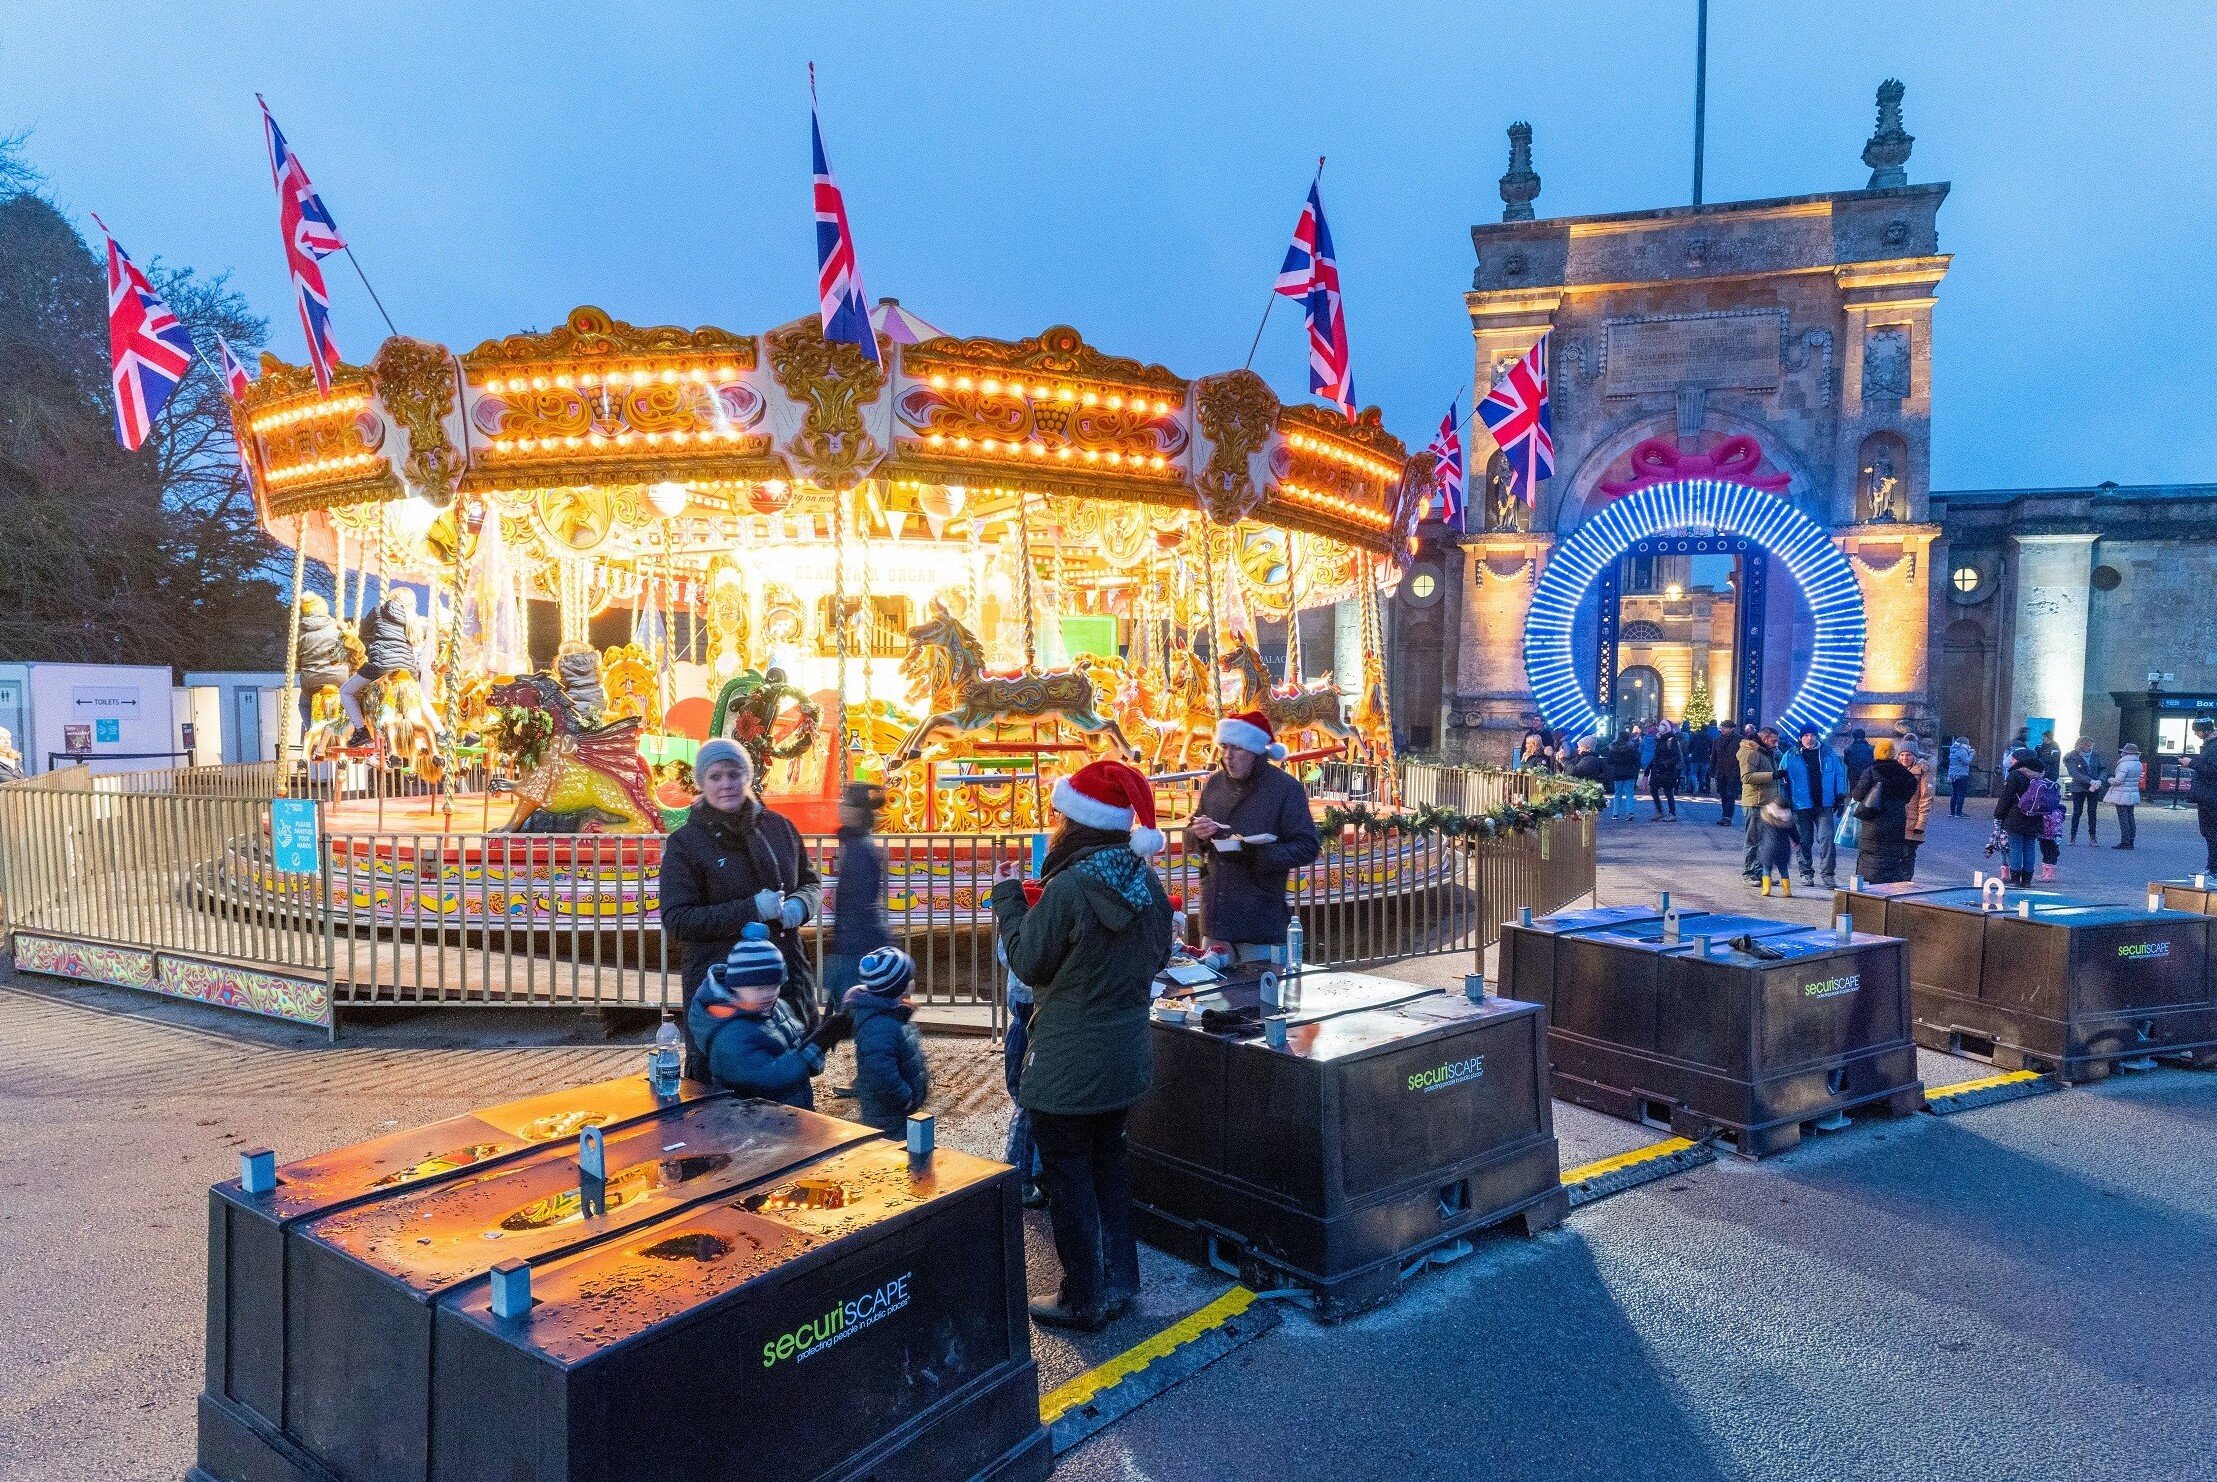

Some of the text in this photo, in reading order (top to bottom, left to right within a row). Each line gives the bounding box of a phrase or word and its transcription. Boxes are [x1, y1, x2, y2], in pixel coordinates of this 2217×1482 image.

[844, 567, 880, 582] FAR
[888, 568, 936, 583] ORGAN
[1259, 655, 1287, 664] PALAC
[797, 1339, 833, 1364] protecting
[833, 1324, 858, 1345] people
[859, 1320, 867, 1330] in
[866, 1309, 887, 1327] public
